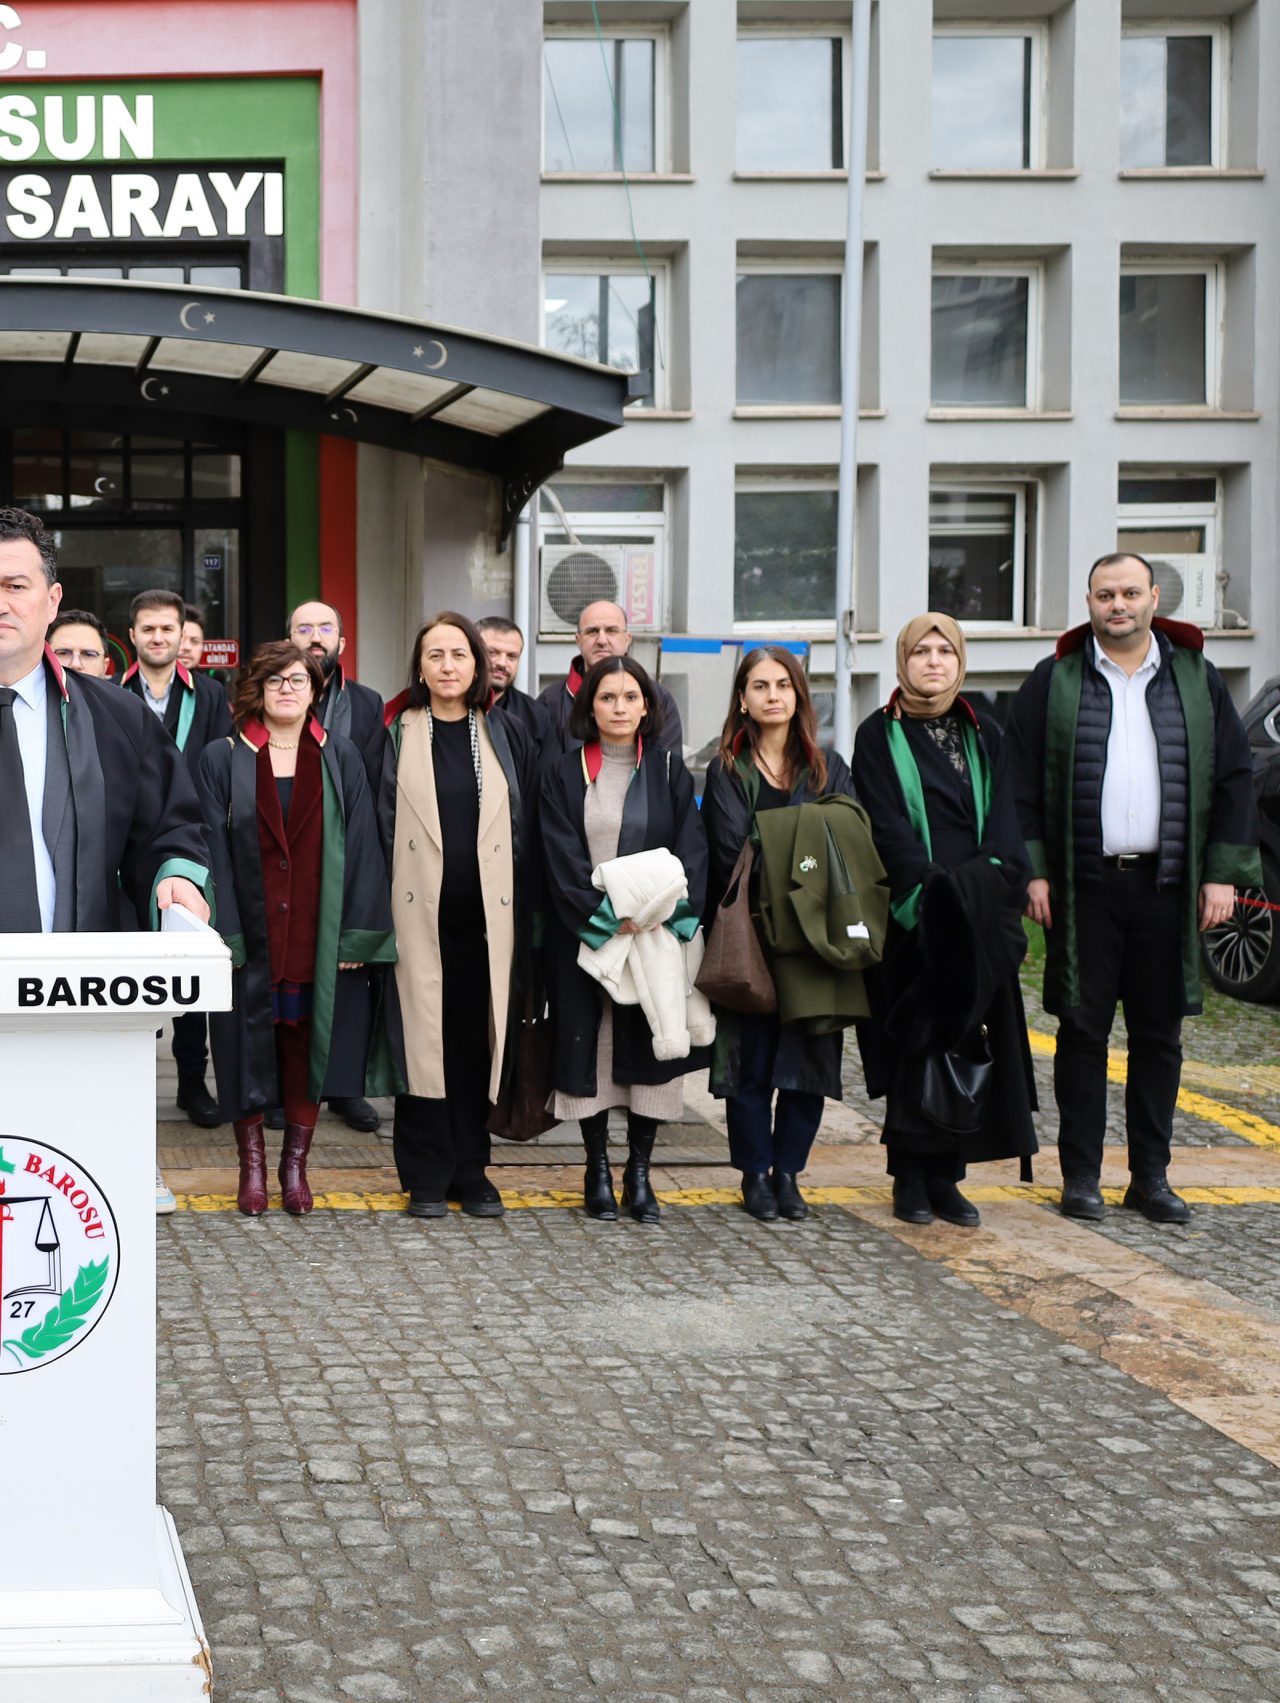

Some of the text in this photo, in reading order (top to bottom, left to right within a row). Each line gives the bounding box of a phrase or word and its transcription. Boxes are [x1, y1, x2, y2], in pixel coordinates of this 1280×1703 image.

[6, 172, 284, 239] SARAYI
[17, 974, 201, 1007] BAROSU
[22, 1152, 105, 1240] BAROSU
[9, 1300, 37, 1319] 27
